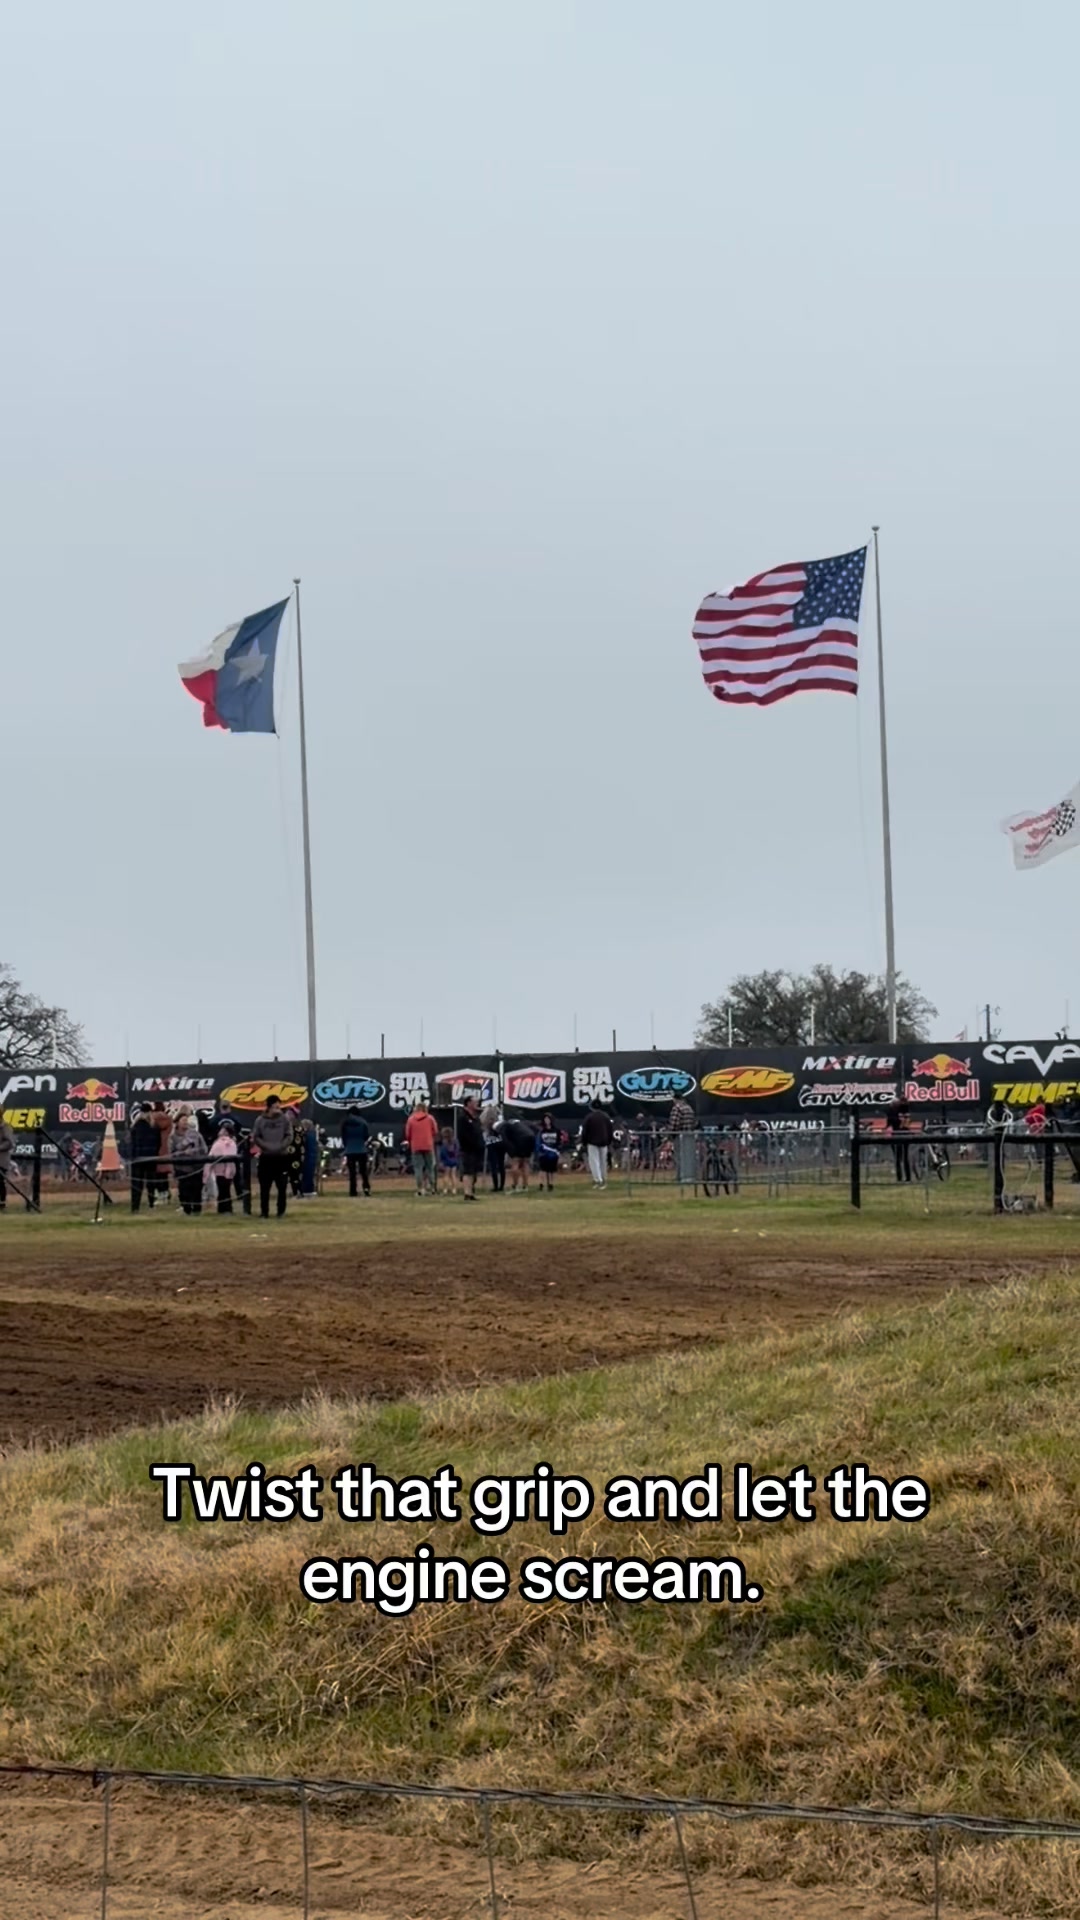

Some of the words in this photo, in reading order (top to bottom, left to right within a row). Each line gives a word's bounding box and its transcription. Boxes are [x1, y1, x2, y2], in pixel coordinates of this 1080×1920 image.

[389, 1072, 428, 1090] STA
[573, 1067, 612, 1085] STA
[620, 1071, 690, 1090] GUTS
[702, 1070, 794, 1090] FMF
[221, 1084, 308, 1102] FMF
[316, 1080, 380, 1099] GUTS
[512, 1076, 557, 1098] 100%
[573, 1085, 614, 1104] CYC
[904, 1080, 941, 1102] Red
[942, 1079, 980, 1101] Bull
[59, 1103, 92, 1122] Red
[92, 1102, 125, 1122] Bull
